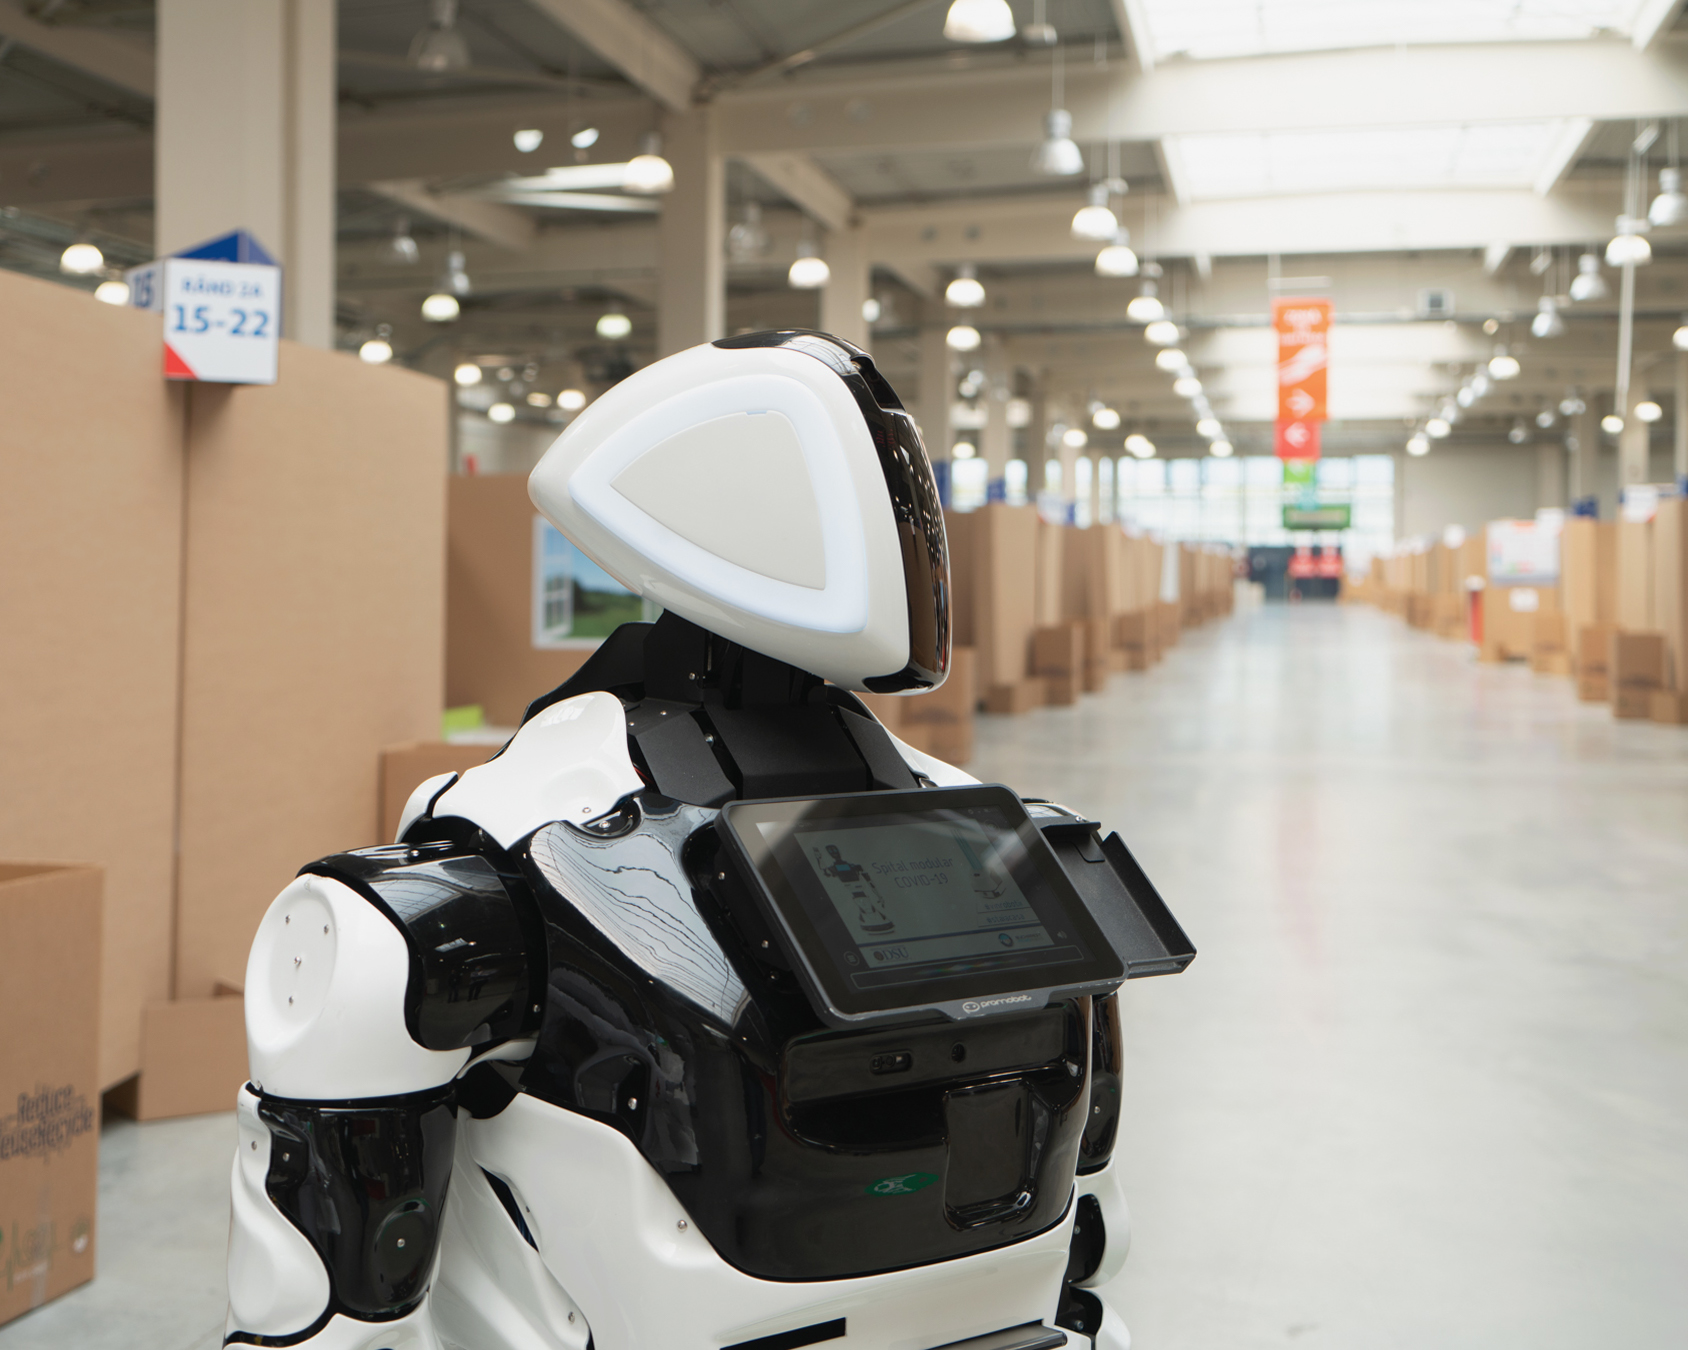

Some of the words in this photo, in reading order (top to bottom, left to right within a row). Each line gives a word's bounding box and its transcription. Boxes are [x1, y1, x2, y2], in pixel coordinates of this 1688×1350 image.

[174, 304, 270, 337] 15-22
[871, 859, 909, 876] Spital
[909, 857, 954, 871] modular
[894, 872, 949, 888] COVID-19
[882, 946, 909, 960] DSU
[980, 994, 1032, 1009] promobot
